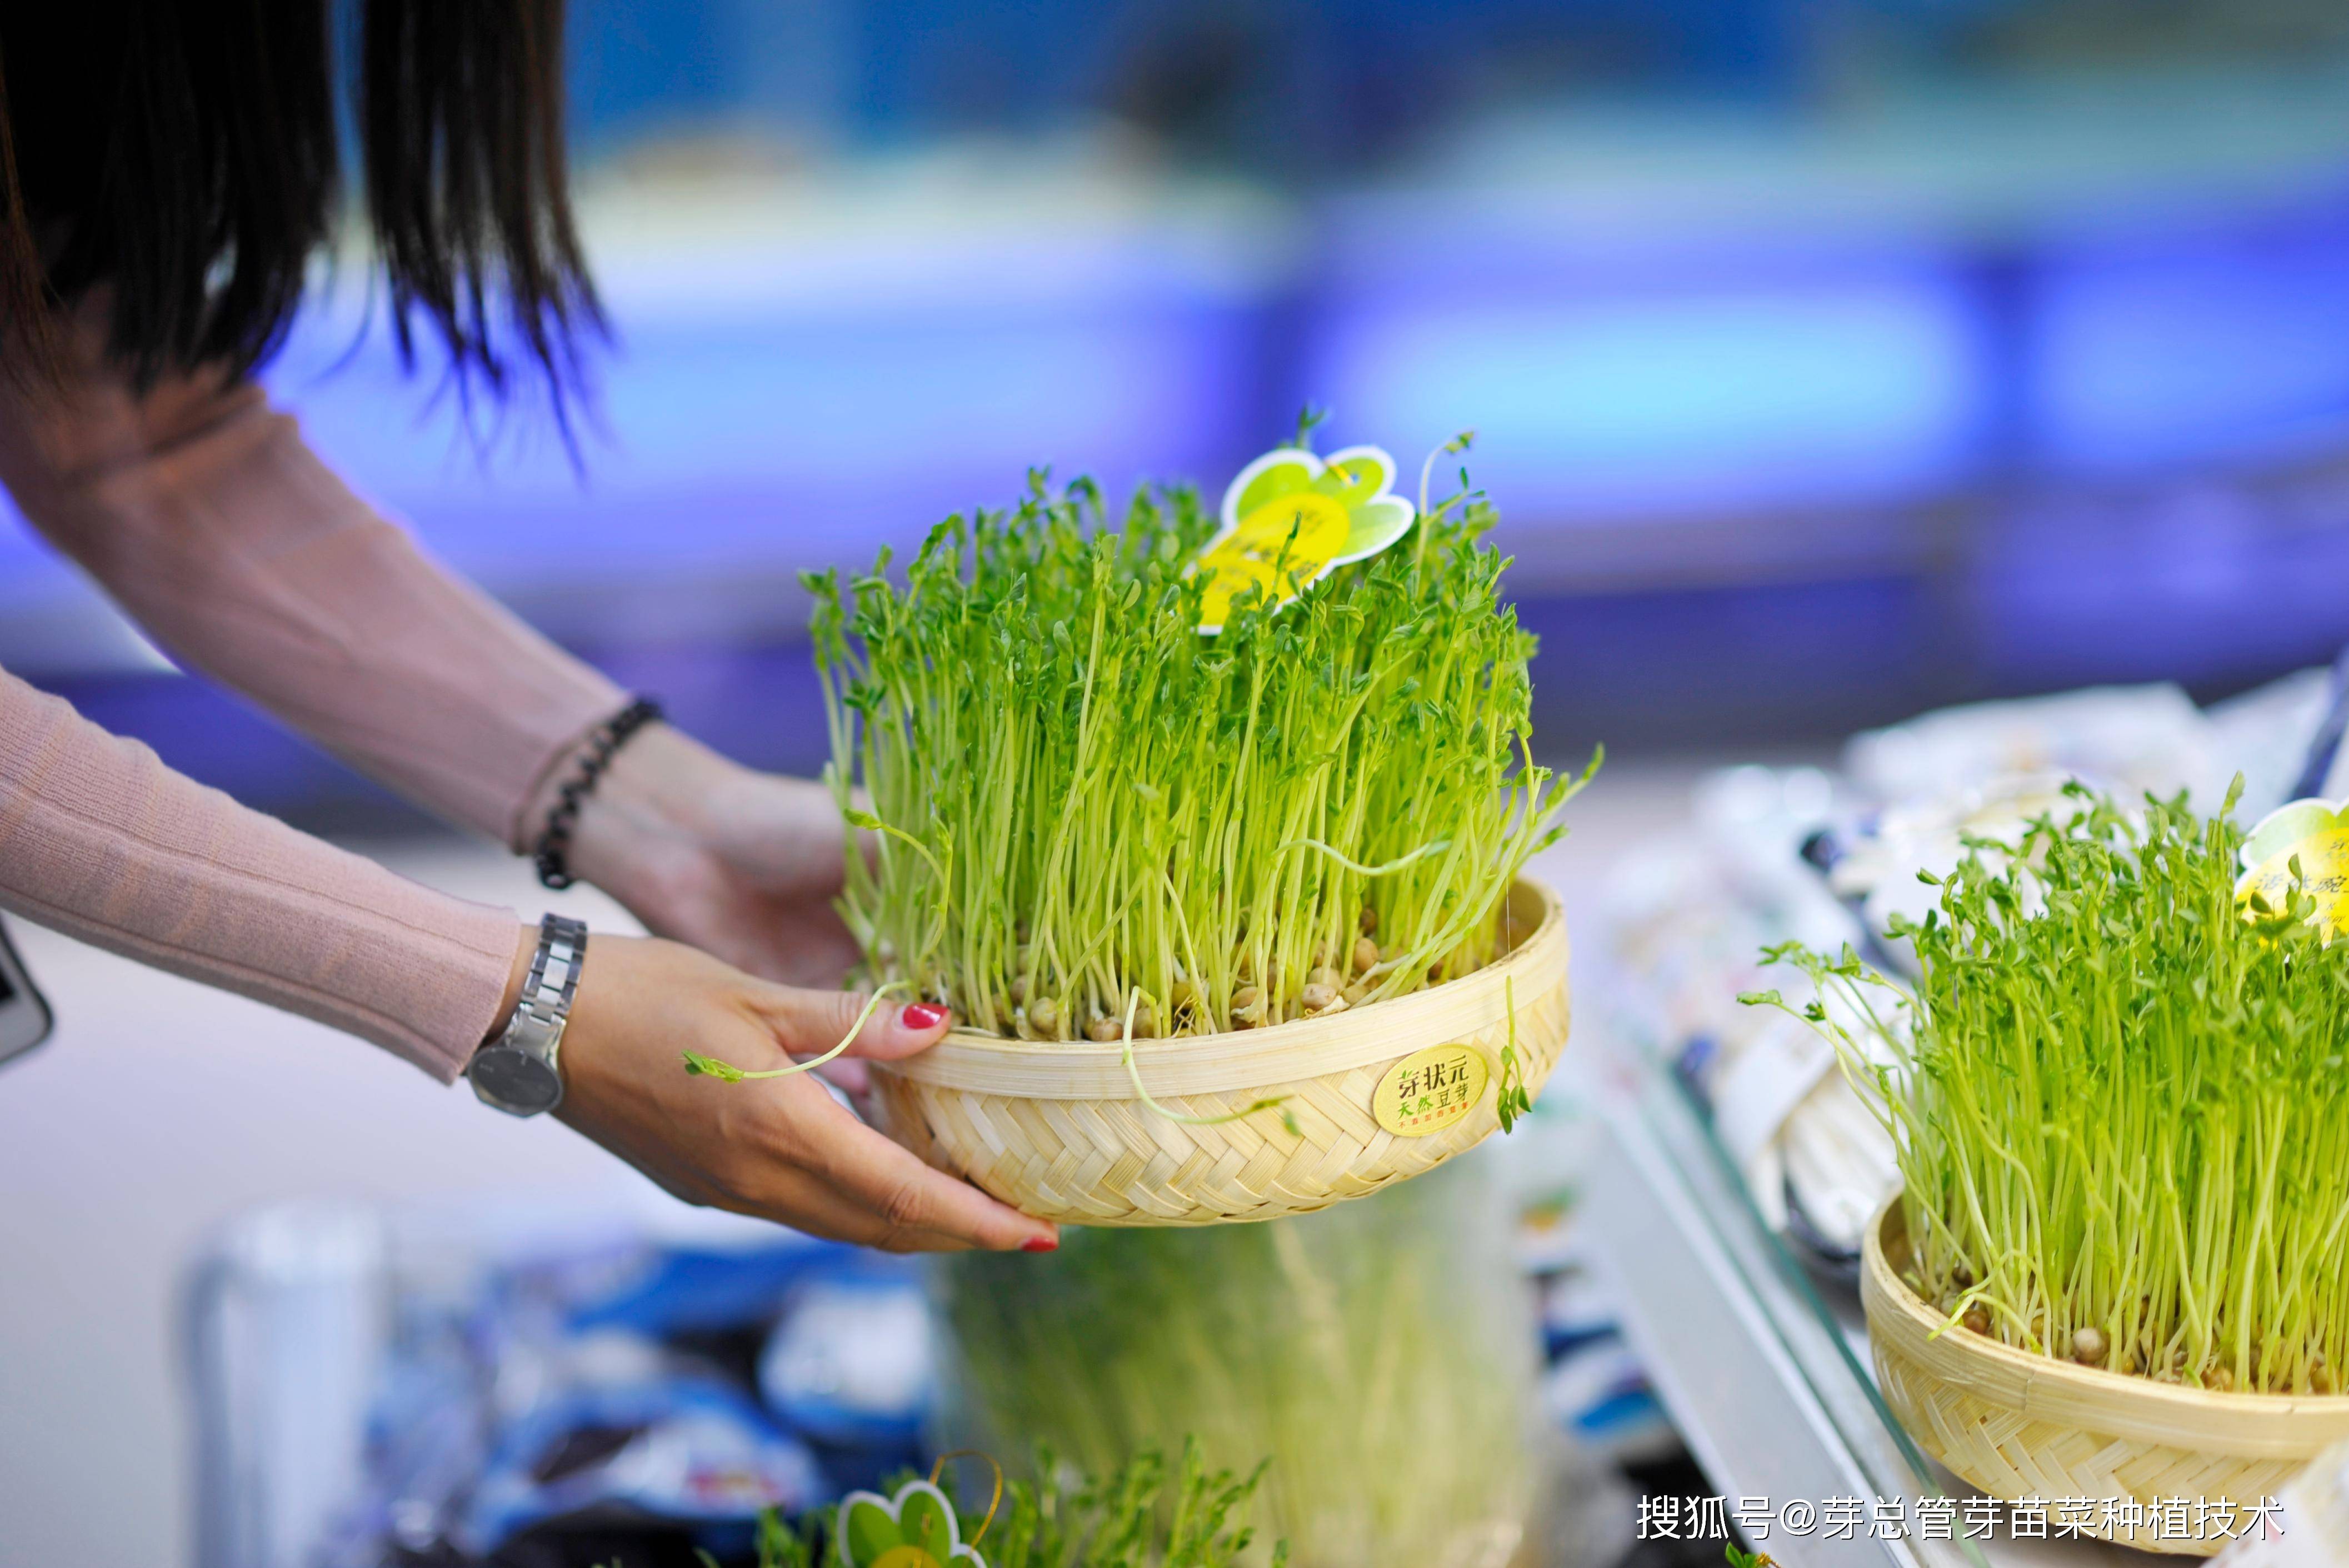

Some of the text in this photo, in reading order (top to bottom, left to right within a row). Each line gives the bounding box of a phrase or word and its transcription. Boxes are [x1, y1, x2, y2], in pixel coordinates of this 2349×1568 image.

[1398, 1055, 1469, 1099] 芽状元
[1398, 1083, 1468, 1120] 天然豆芽
